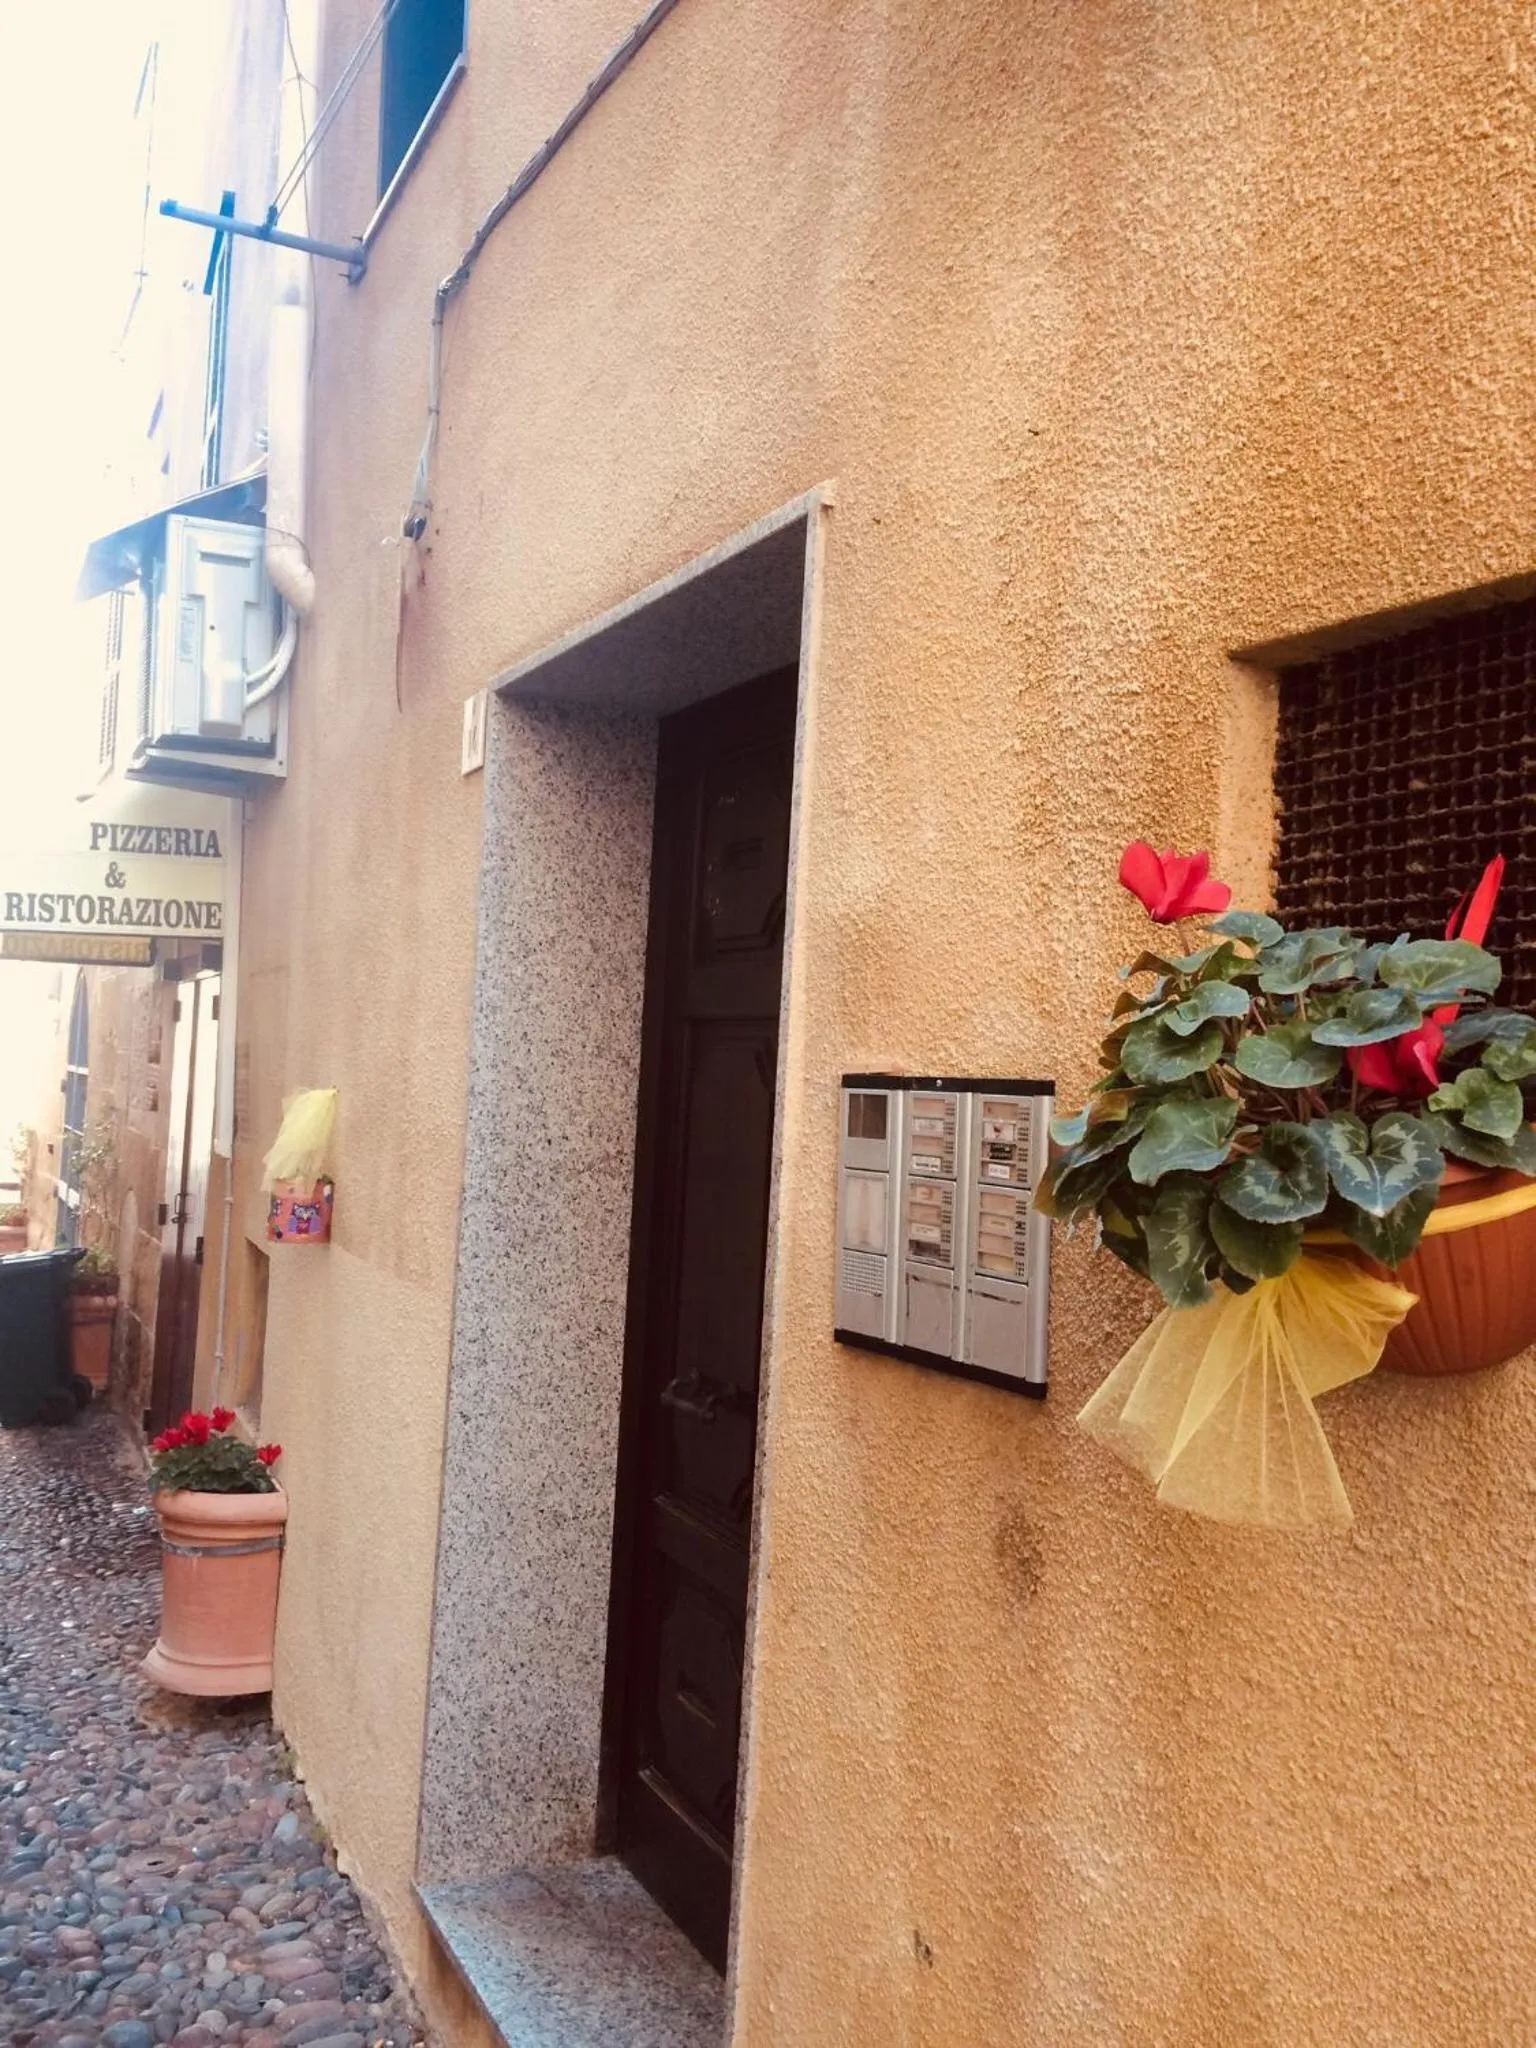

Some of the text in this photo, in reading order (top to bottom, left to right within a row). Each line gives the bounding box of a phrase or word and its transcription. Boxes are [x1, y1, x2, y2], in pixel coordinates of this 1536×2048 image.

[89, 822, 222, 858] PIZZERIA
[105, 861, 126, 889] &
[4, 891, 222, 929] RISTORAZIONE
